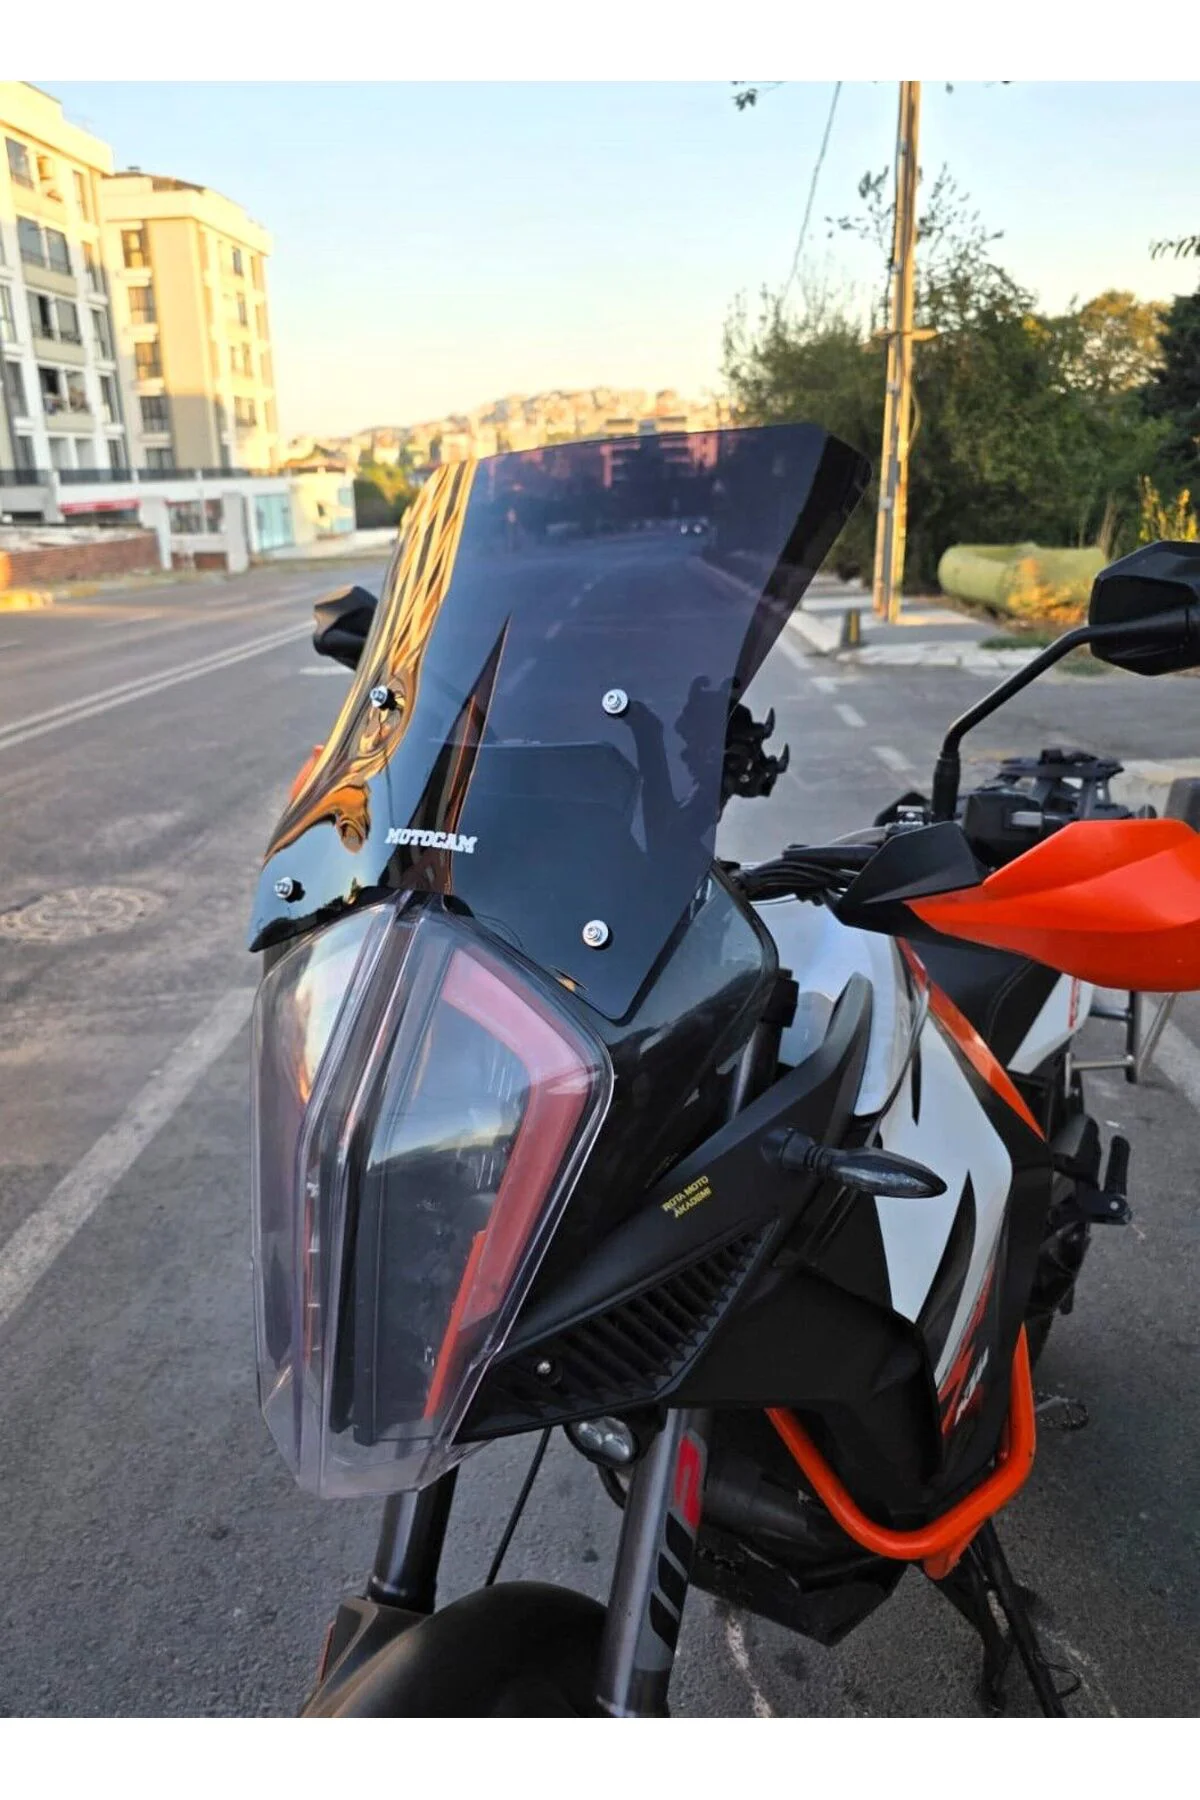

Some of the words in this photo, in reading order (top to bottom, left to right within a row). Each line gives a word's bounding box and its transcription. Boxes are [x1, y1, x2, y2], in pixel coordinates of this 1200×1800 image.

[384, 828, 478, 854] MOTOCAM
[662, 1193, 686, 1212] ROTA
[684, 1175, 709, 1195] MOTO
